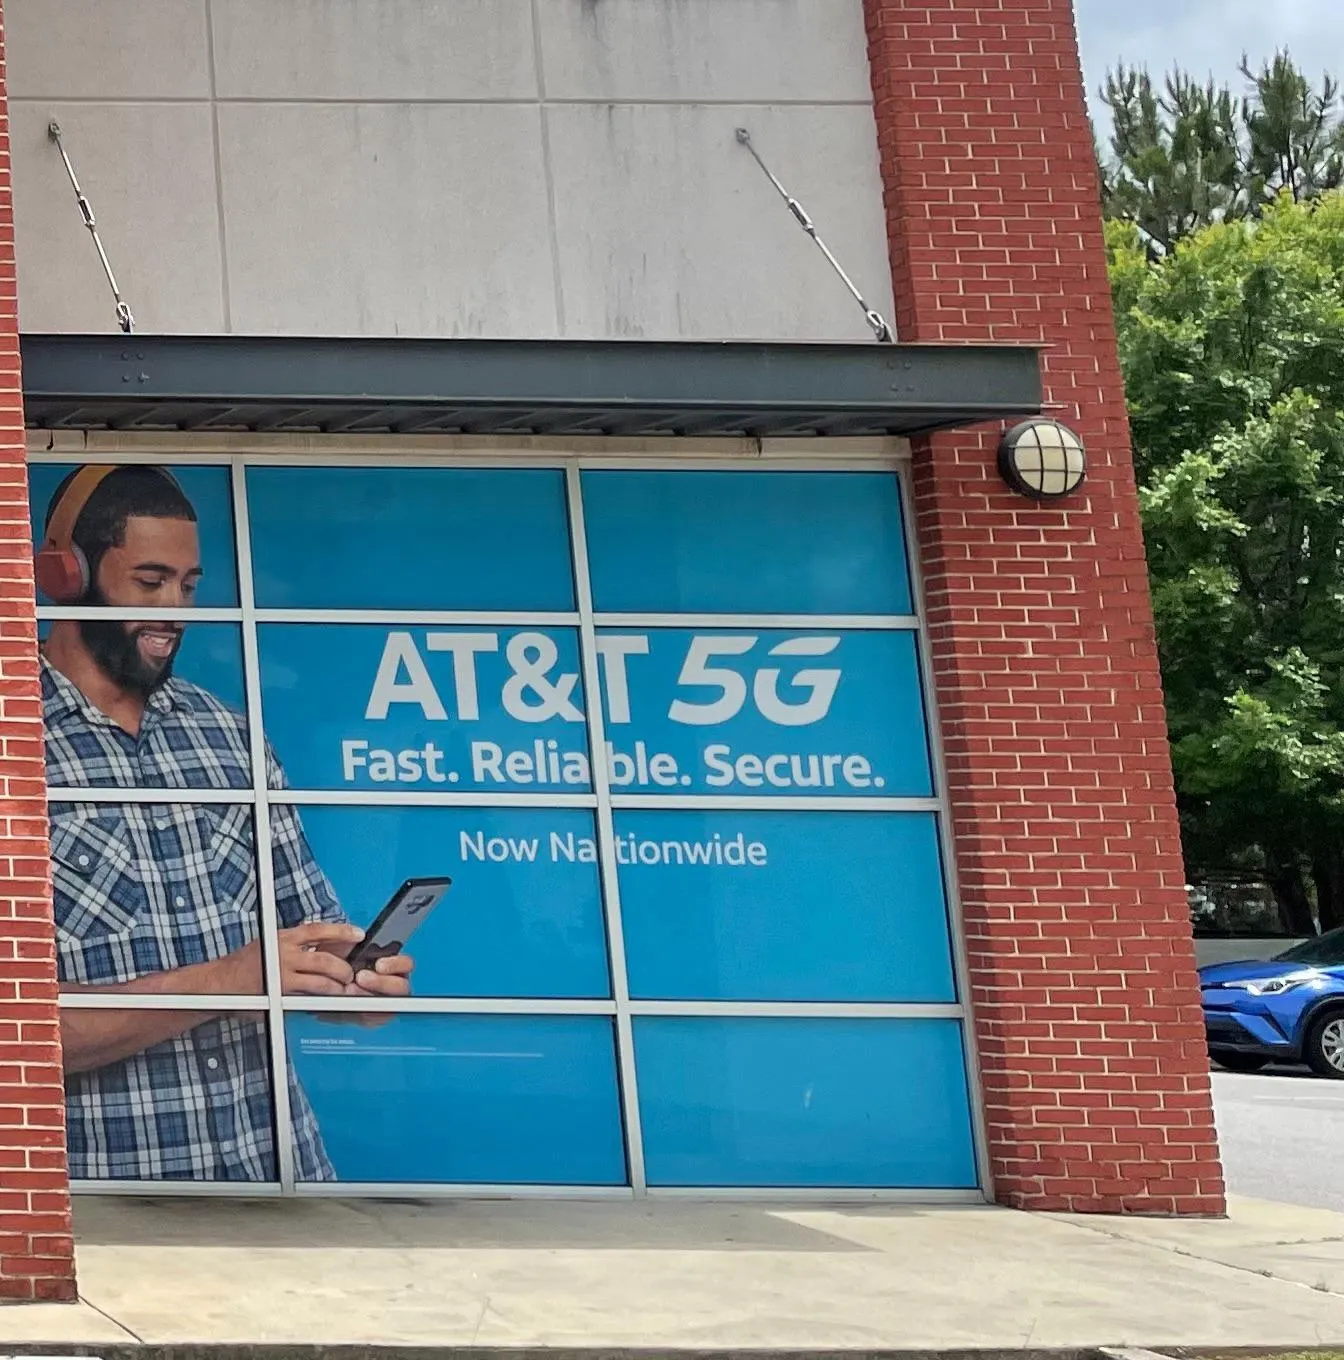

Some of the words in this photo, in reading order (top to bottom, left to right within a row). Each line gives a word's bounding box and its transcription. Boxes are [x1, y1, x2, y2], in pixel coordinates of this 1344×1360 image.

[364, 631, 649, 723] AT&T
[668, 636, 842, 726] 5G
[341, 739, 459, 784] Fast.
[472, 739, 692, 787] Reliable.
[703, 744, 886, 788] Secure.
[459, 831, 539, 862] Now
[550, 831, 769, 866] Nationwide
